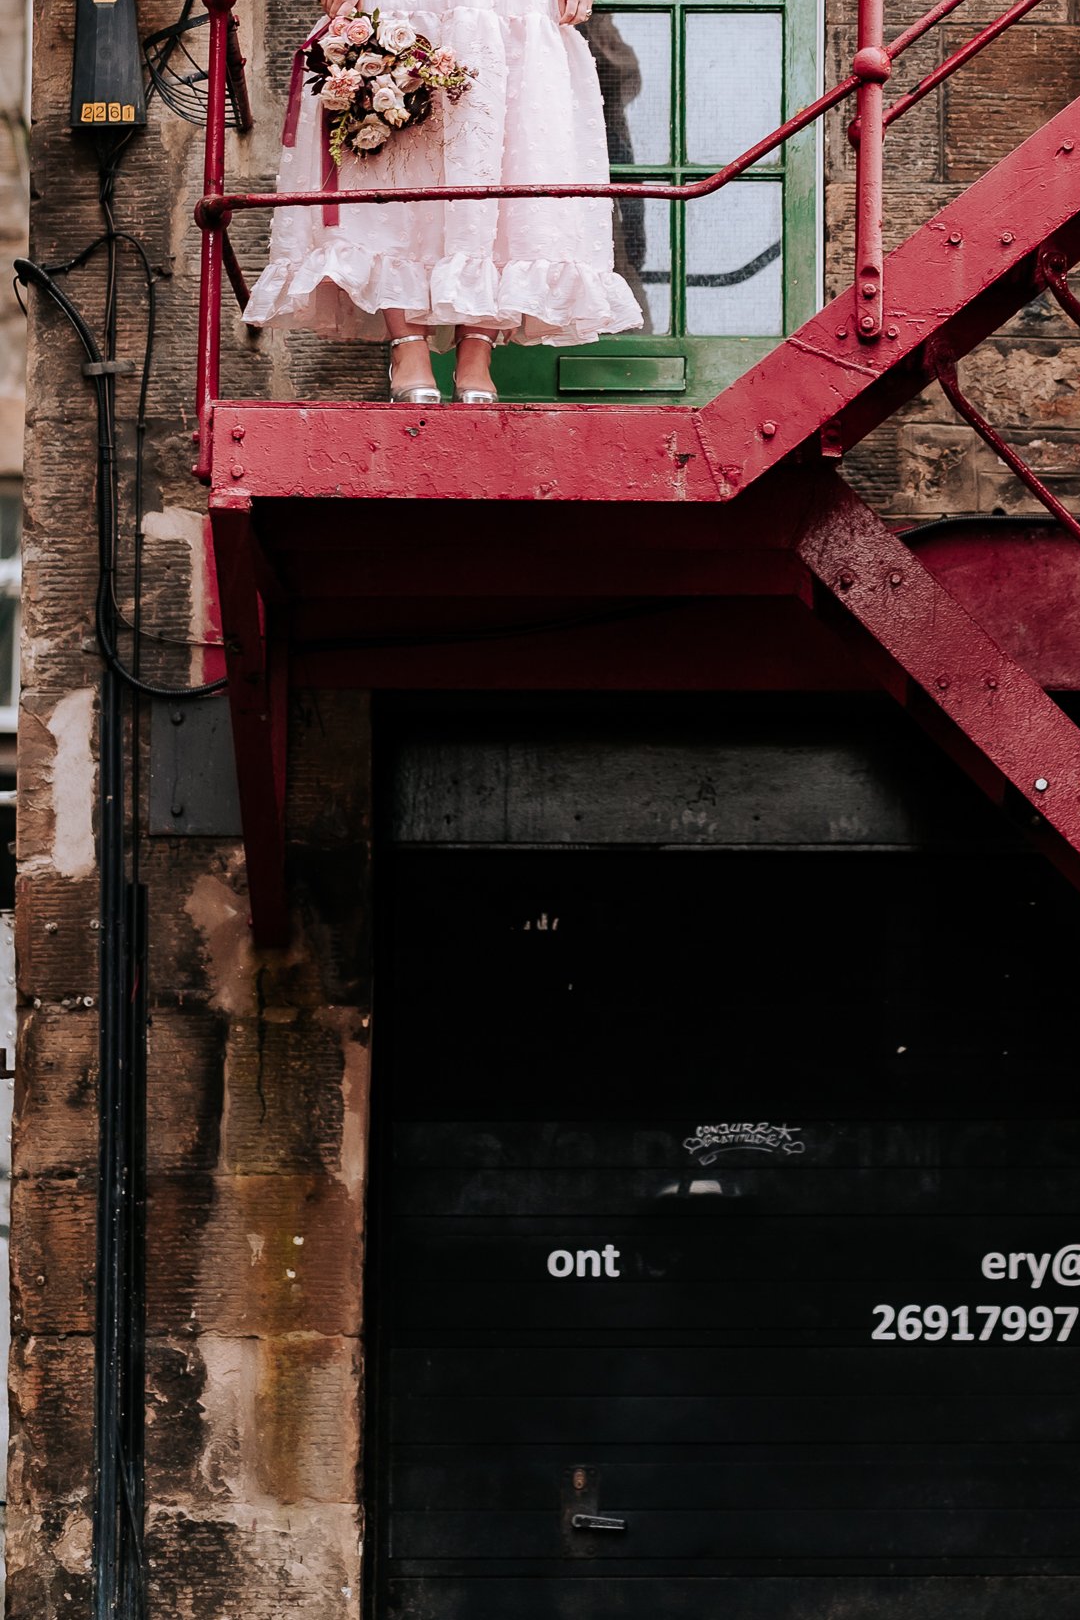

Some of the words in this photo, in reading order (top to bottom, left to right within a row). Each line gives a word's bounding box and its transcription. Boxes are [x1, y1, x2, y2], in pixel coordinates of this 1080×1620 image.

[83, 105, 131, 119] 2261
[547, 1244, 620, 1277] ont
[870, 1304, 1080, 1342] 26917997
